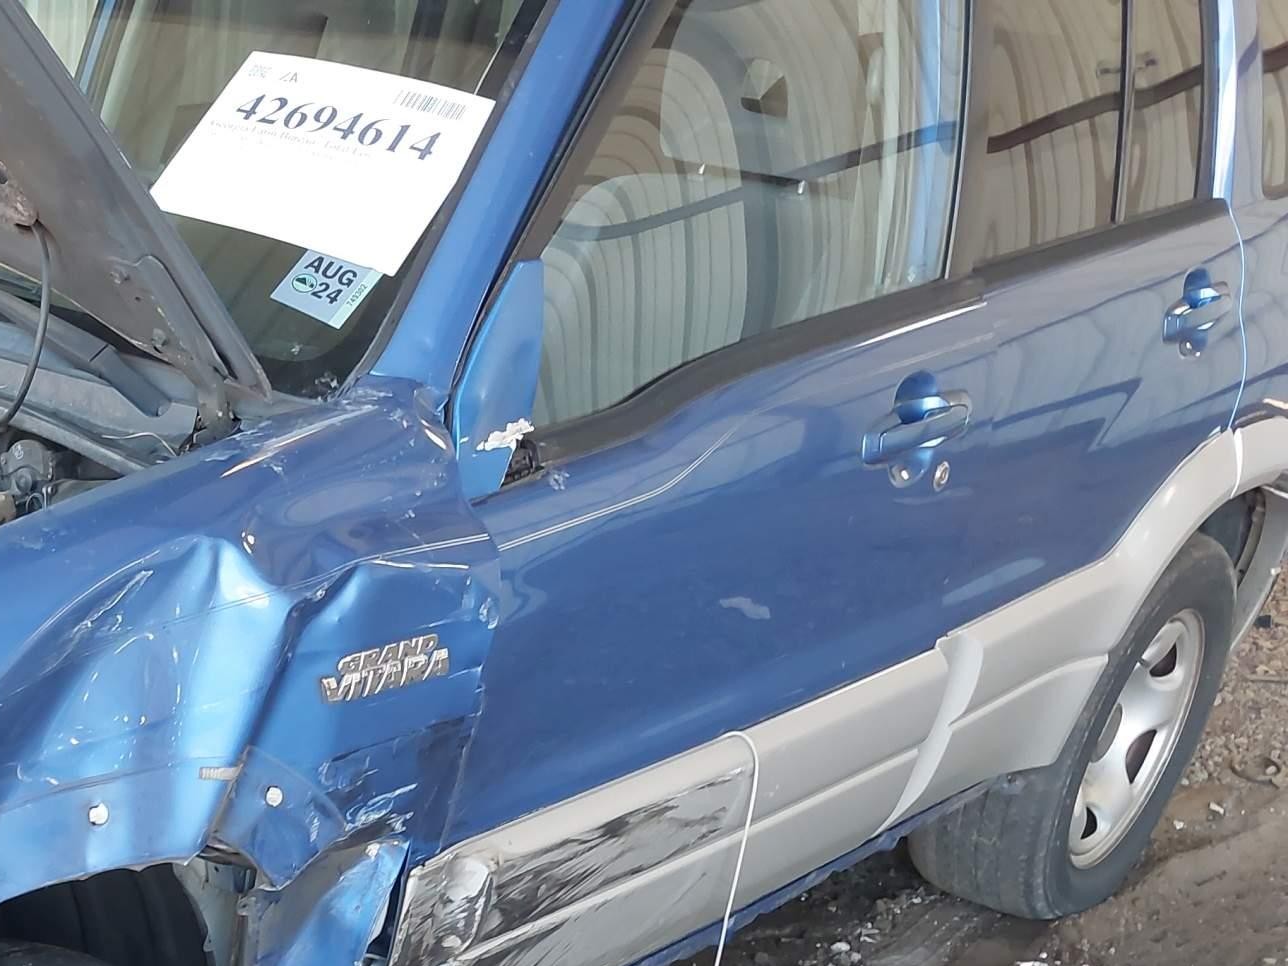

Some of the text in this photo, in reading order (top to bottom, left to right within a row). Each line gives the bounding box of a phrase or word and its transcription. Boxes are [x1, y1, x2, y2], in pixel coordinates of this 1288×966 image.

[236, 94, 441, 160] 42694614
[304, 256, 358, 288] AUG
[311, 282, 343, 304] 24
